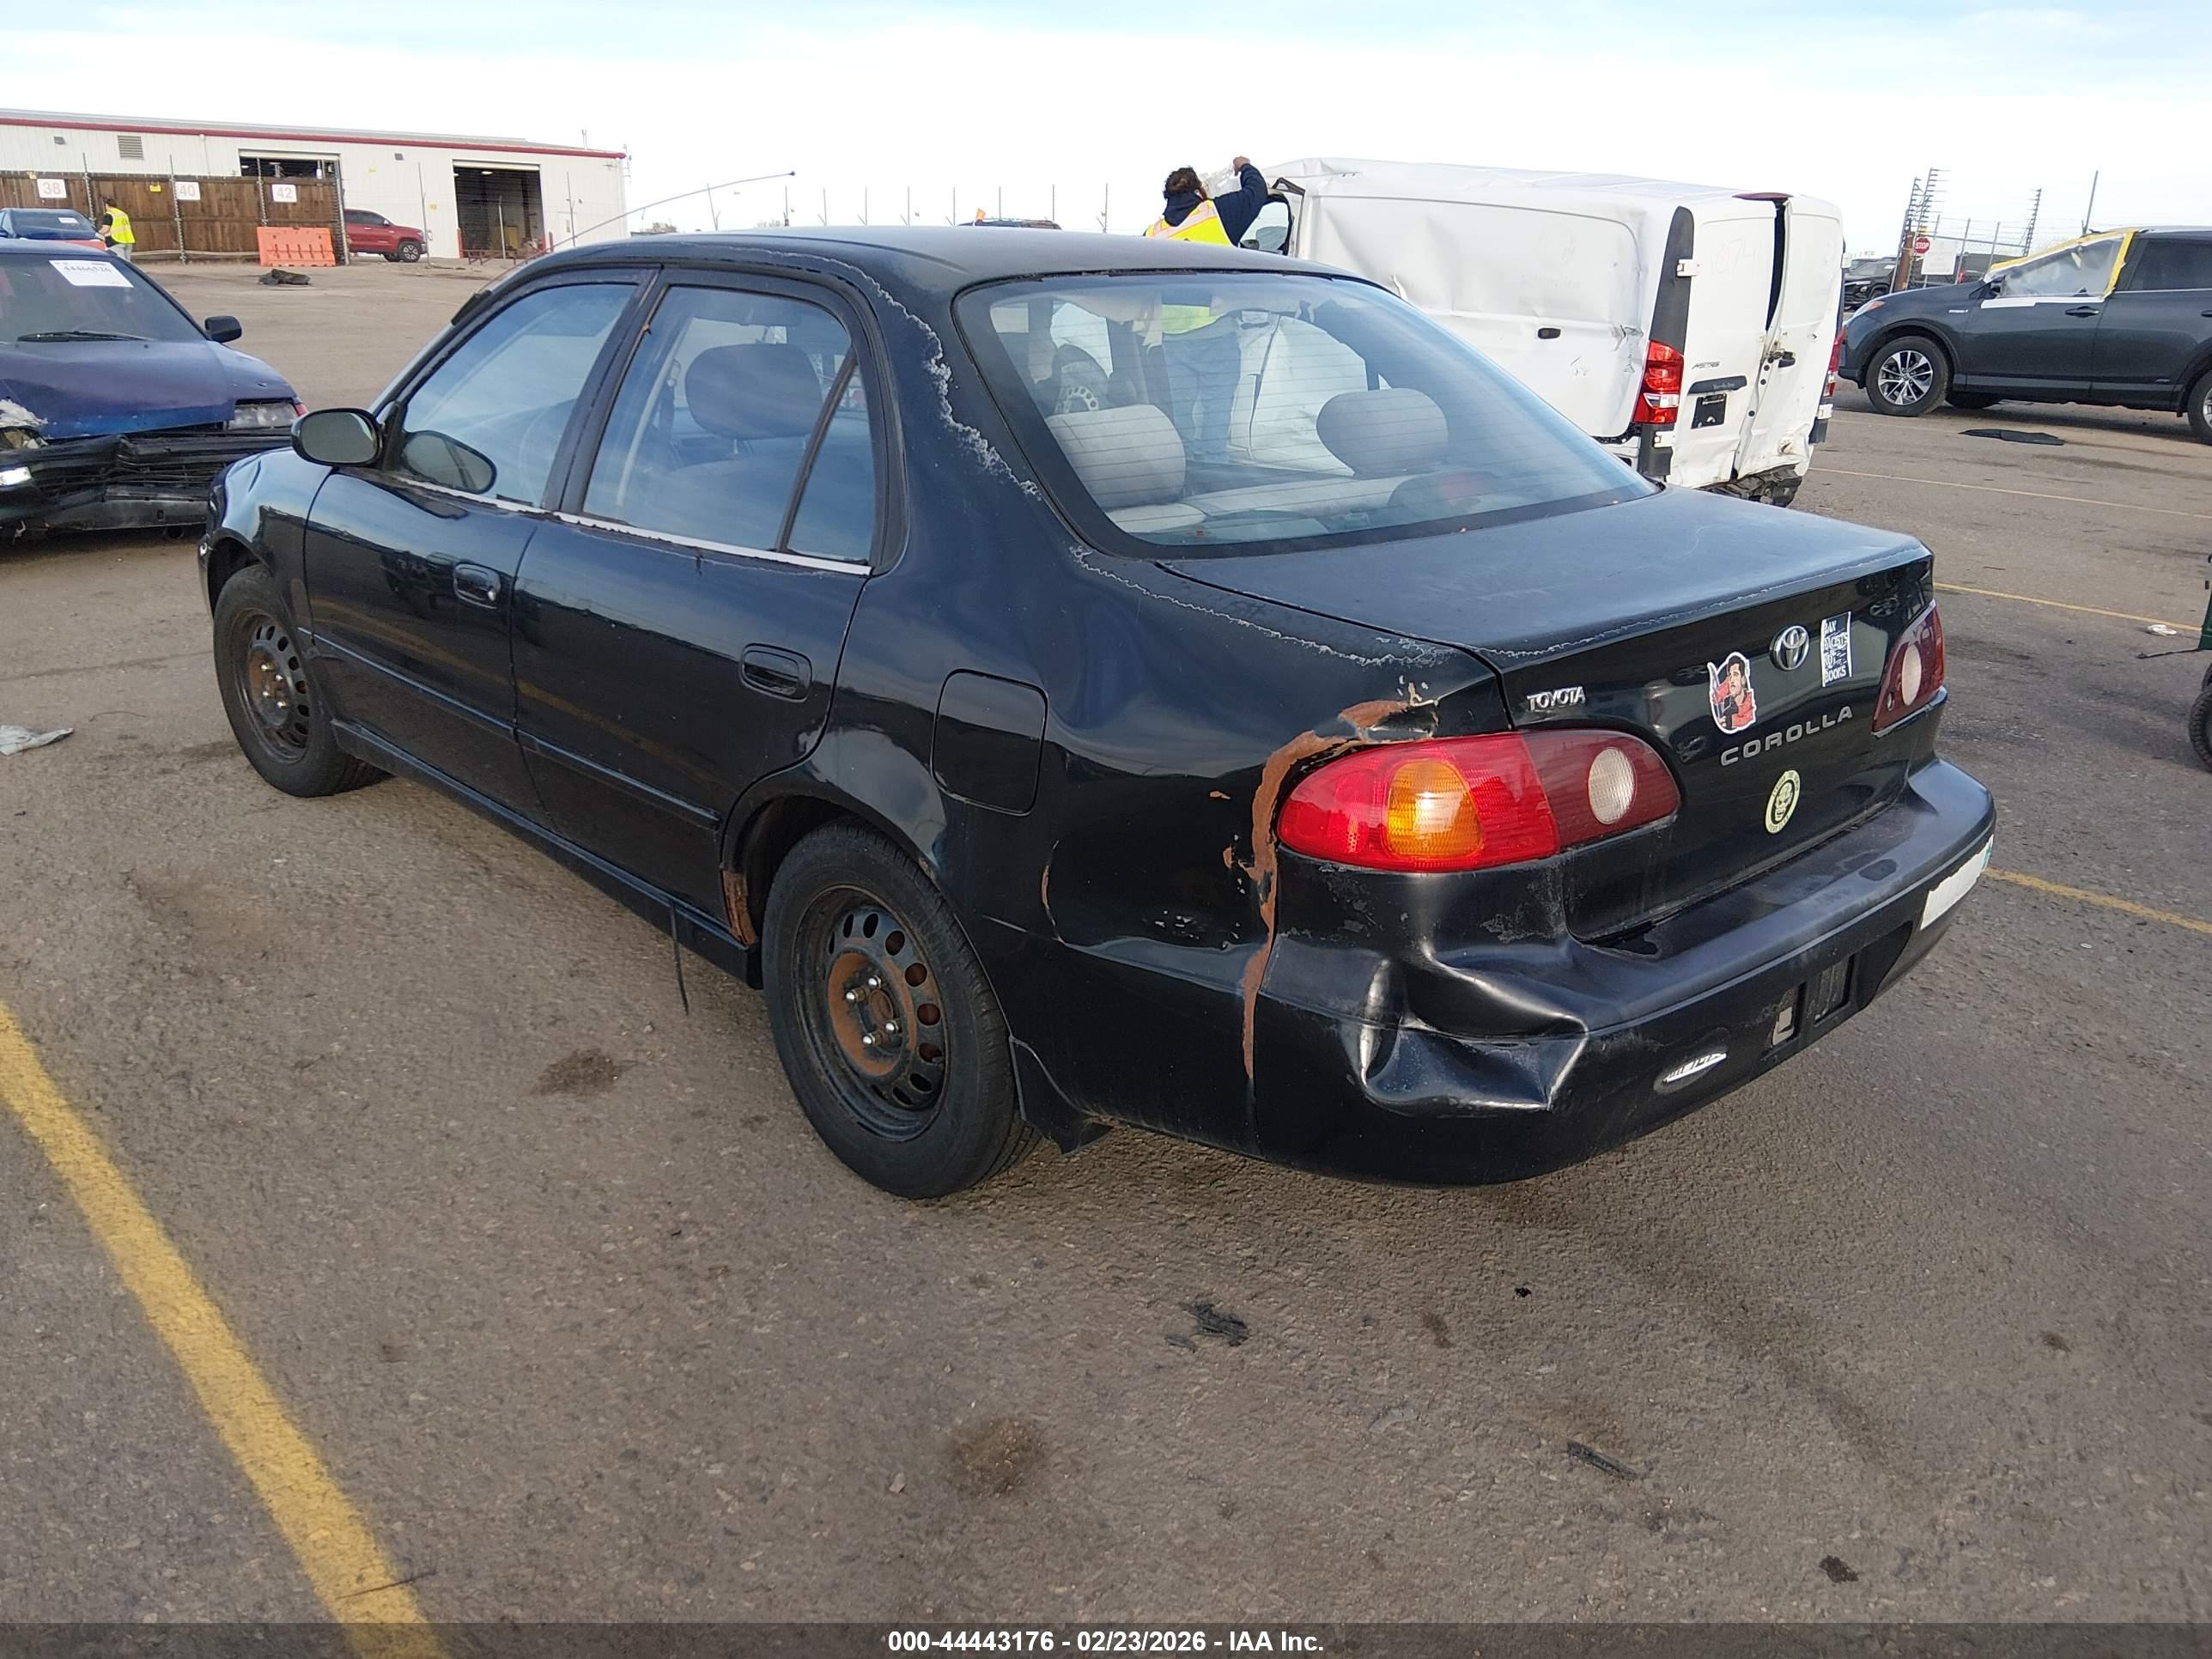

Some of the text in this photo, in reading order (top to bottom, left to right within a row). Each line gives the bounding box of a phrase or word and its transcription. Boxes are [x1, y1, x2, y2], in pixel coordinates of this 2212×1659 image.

[43, 182, 61, 195] 38
[179, 185, 196, 197] 40
[276, 186, 293, 198] 42
[1527, 686, 1586, 711] TOYOTA
[1720, 706, 1853, 766] COROLLA
